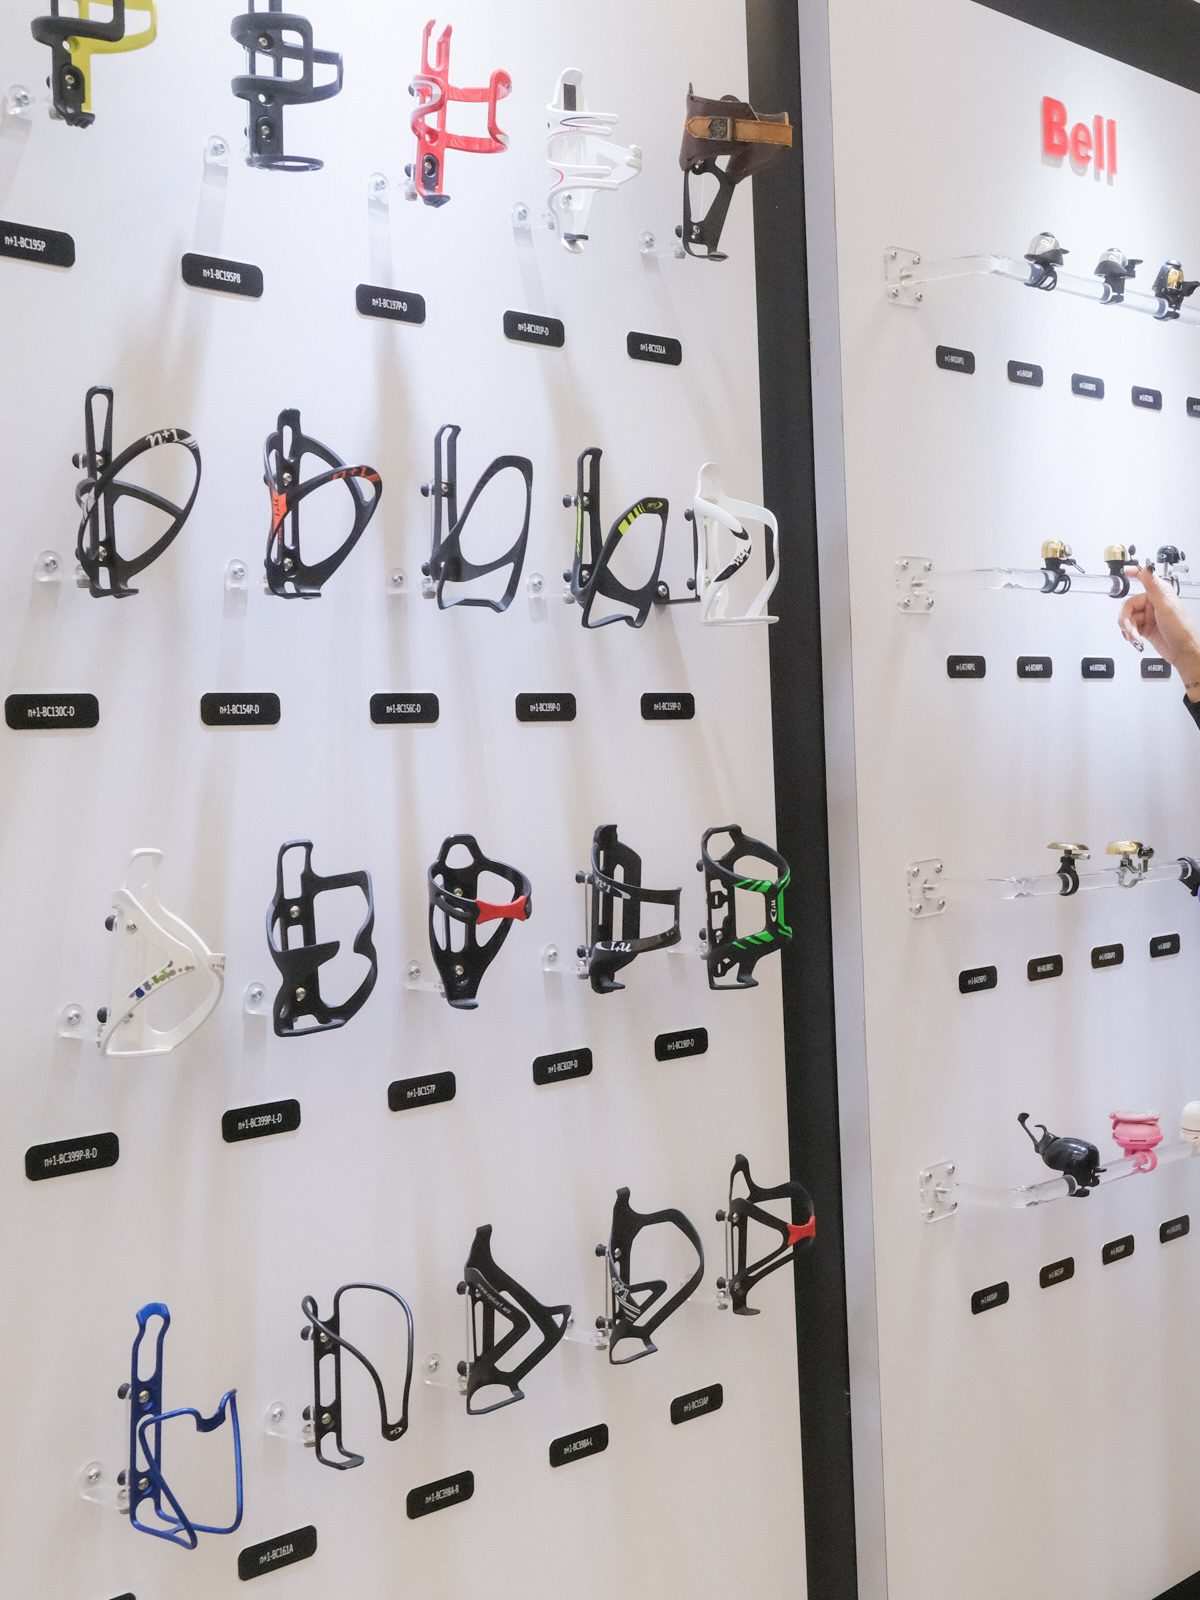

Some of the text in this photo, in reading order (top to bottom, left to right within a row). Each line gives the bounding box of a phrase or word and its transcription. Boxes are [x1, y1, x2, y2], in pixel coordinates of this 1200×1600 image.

[1042, 95, 1118, 177] Bell
[27, 706, 75, 718] n+1-BC130C-D
[219, 704, 260, 715] n+1-BC154P-D
[237, 1113, 283, 1131] n+1-BC399P-L-D
[44, 1147, 98, 1167] n+1-BC399P-R-D
